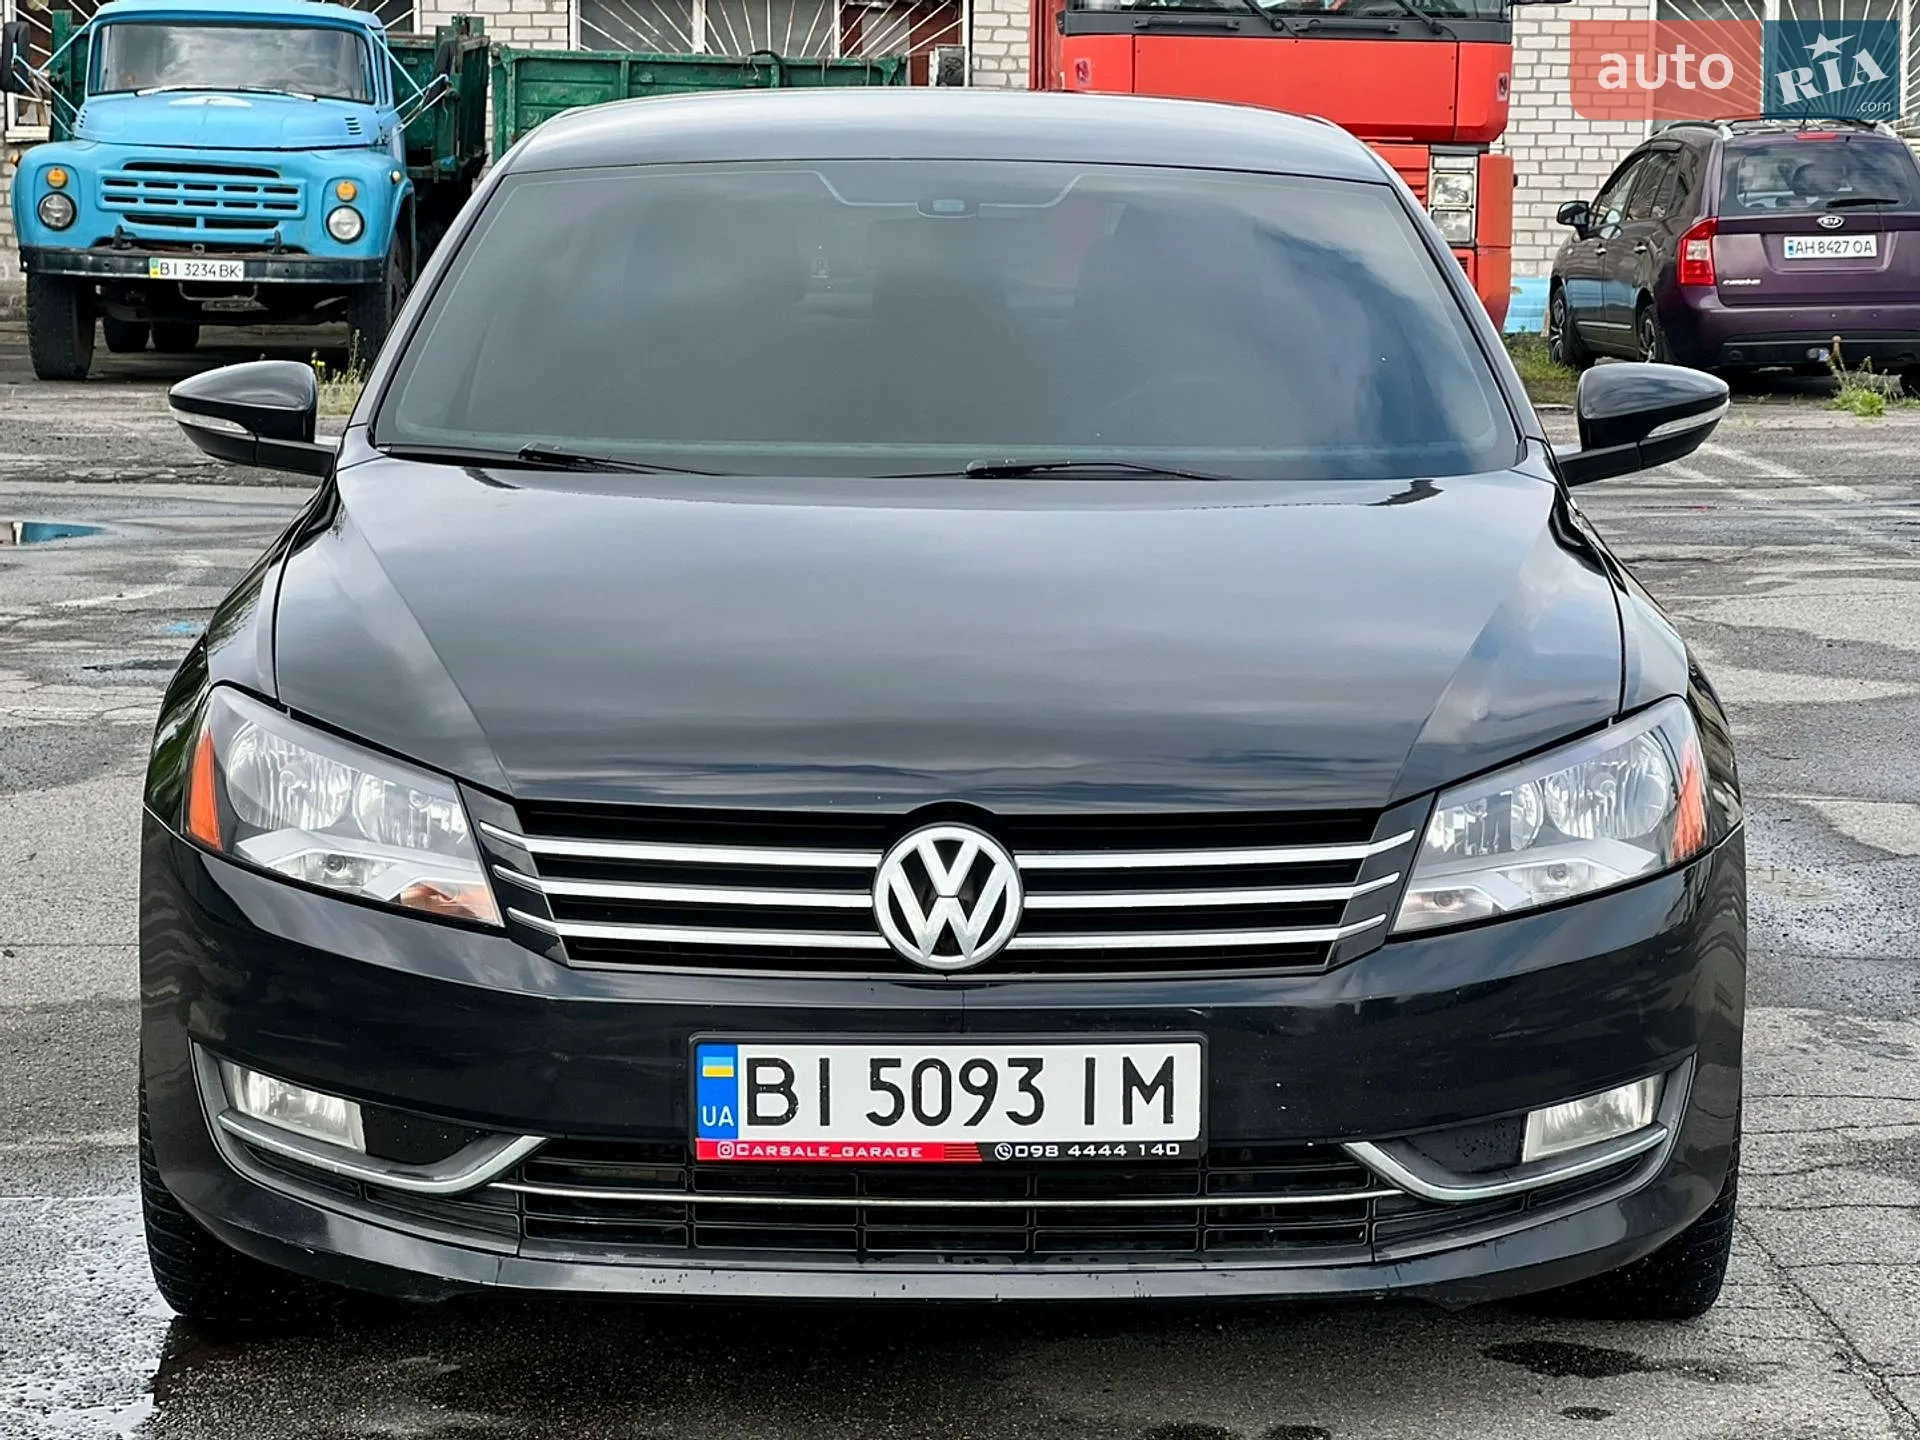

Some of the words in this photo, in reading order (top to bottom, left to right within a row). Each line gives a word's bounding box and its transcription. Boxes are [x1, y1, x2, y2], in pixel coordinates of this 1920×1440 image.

[1795, 241, 1815, 254] AH
[1818, 240, 1850, 254] 8427
[1853, 240, 1873, 253] OA
[160, 262, 178, 276] BI
[184, 263, 216, 277] 3234
[219, 264, 240, 278] BK
[746, 1057, 831, 1127] BI
[865, 1057, 1045, 1126] 5093
[1084, 1056, 1175, 1125] IM
[702, 1105, 734, 1126] UA
[1015, 1145, 1059, 1158] 098
[1067, 1144, 1127, 1157] 4444
[1138, 1143, 1180, 1156] 140
